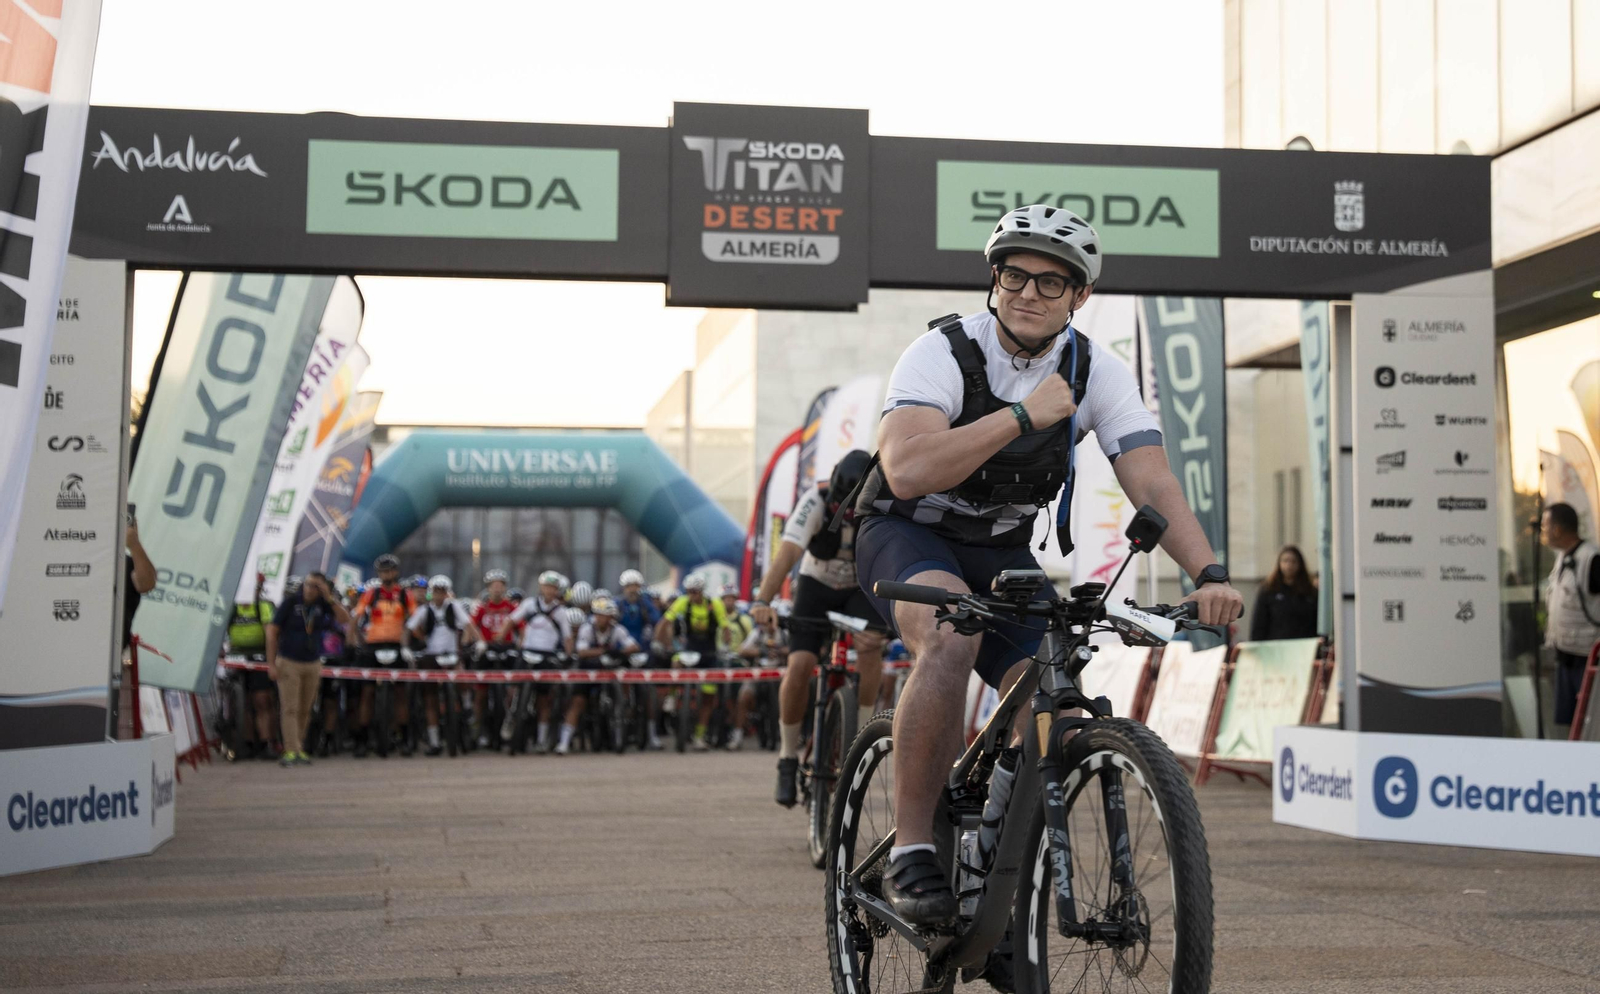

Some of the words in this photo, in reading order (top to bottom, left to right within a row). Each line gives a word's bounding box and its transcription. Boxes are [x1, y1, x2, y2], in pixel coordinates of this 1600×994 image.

[91, 130, 268, 177] Andalucía
[683, 136, 844, 194] TITAN
[703, 204, 843, 232] DESERT
[721, 238, 820, 259] ALMERÍA
[1250, 235, 1349, 254] DIPUTACIÓN
[1353, 240, 1374, 255] DE
[1377, 238, 1449, 257] ALMERÍA
[1408, 320, 1465, 333] ALMERÍA
[1401, 371, 1476, 385] Cleardent
[44, 528, 96, 542] Atalaya
[1299, 766, 1353, 800] Cleardent
[1430, 775, 1600, 817] Cleardent
[8, 780, 139, 832] Cleardent
